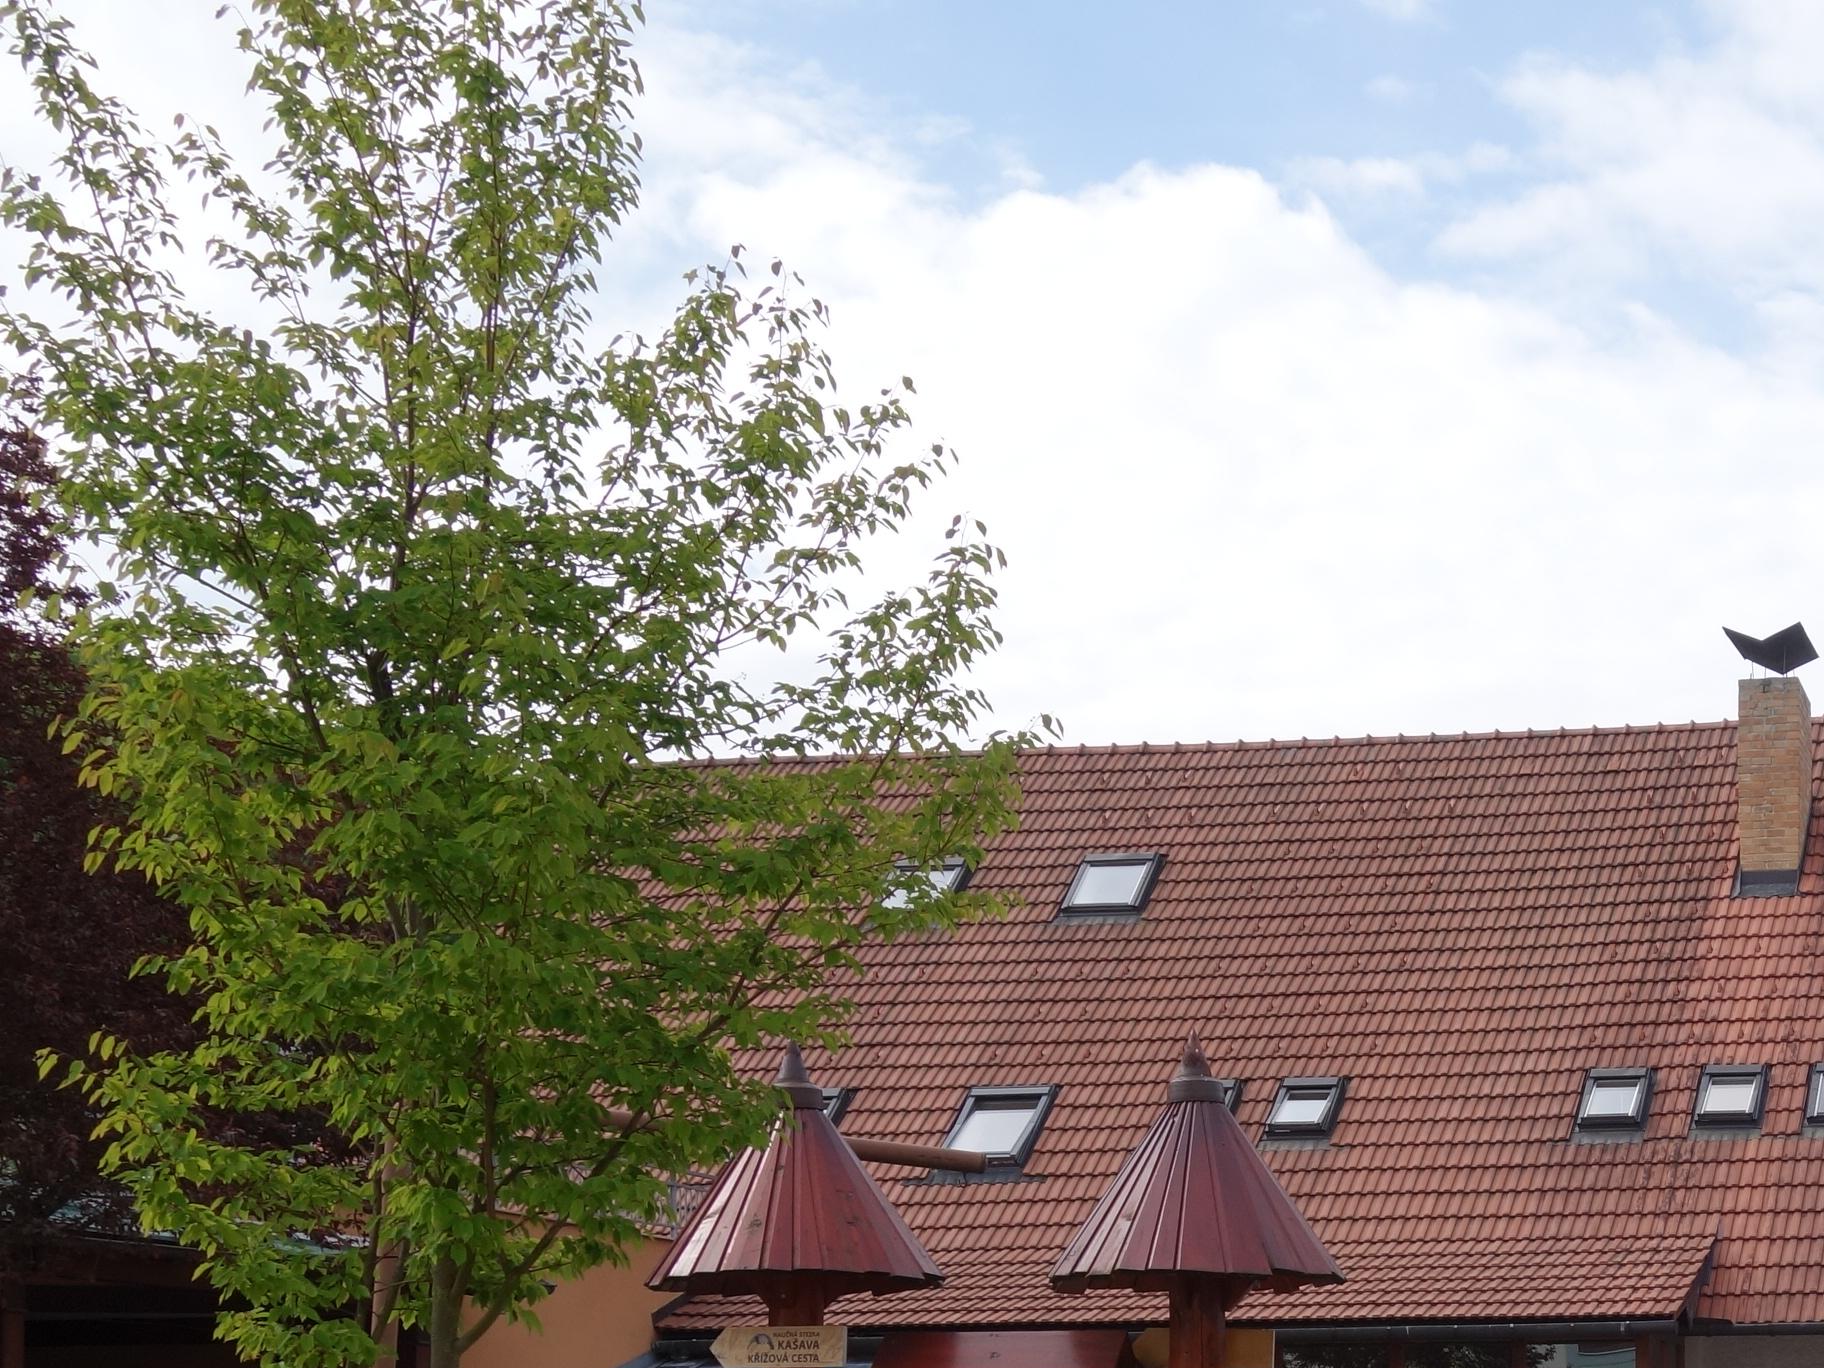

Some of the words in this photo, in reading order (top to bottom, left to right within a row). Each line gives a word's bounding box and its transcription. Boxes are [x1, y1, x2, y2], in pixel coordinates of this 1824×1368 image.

[777, 1338, 820, 1350] KAŠAVA
[747, 1352, 789, 1363] KŘÍŽOVÁ
[791, 1354, 820, 1363] CESTA
